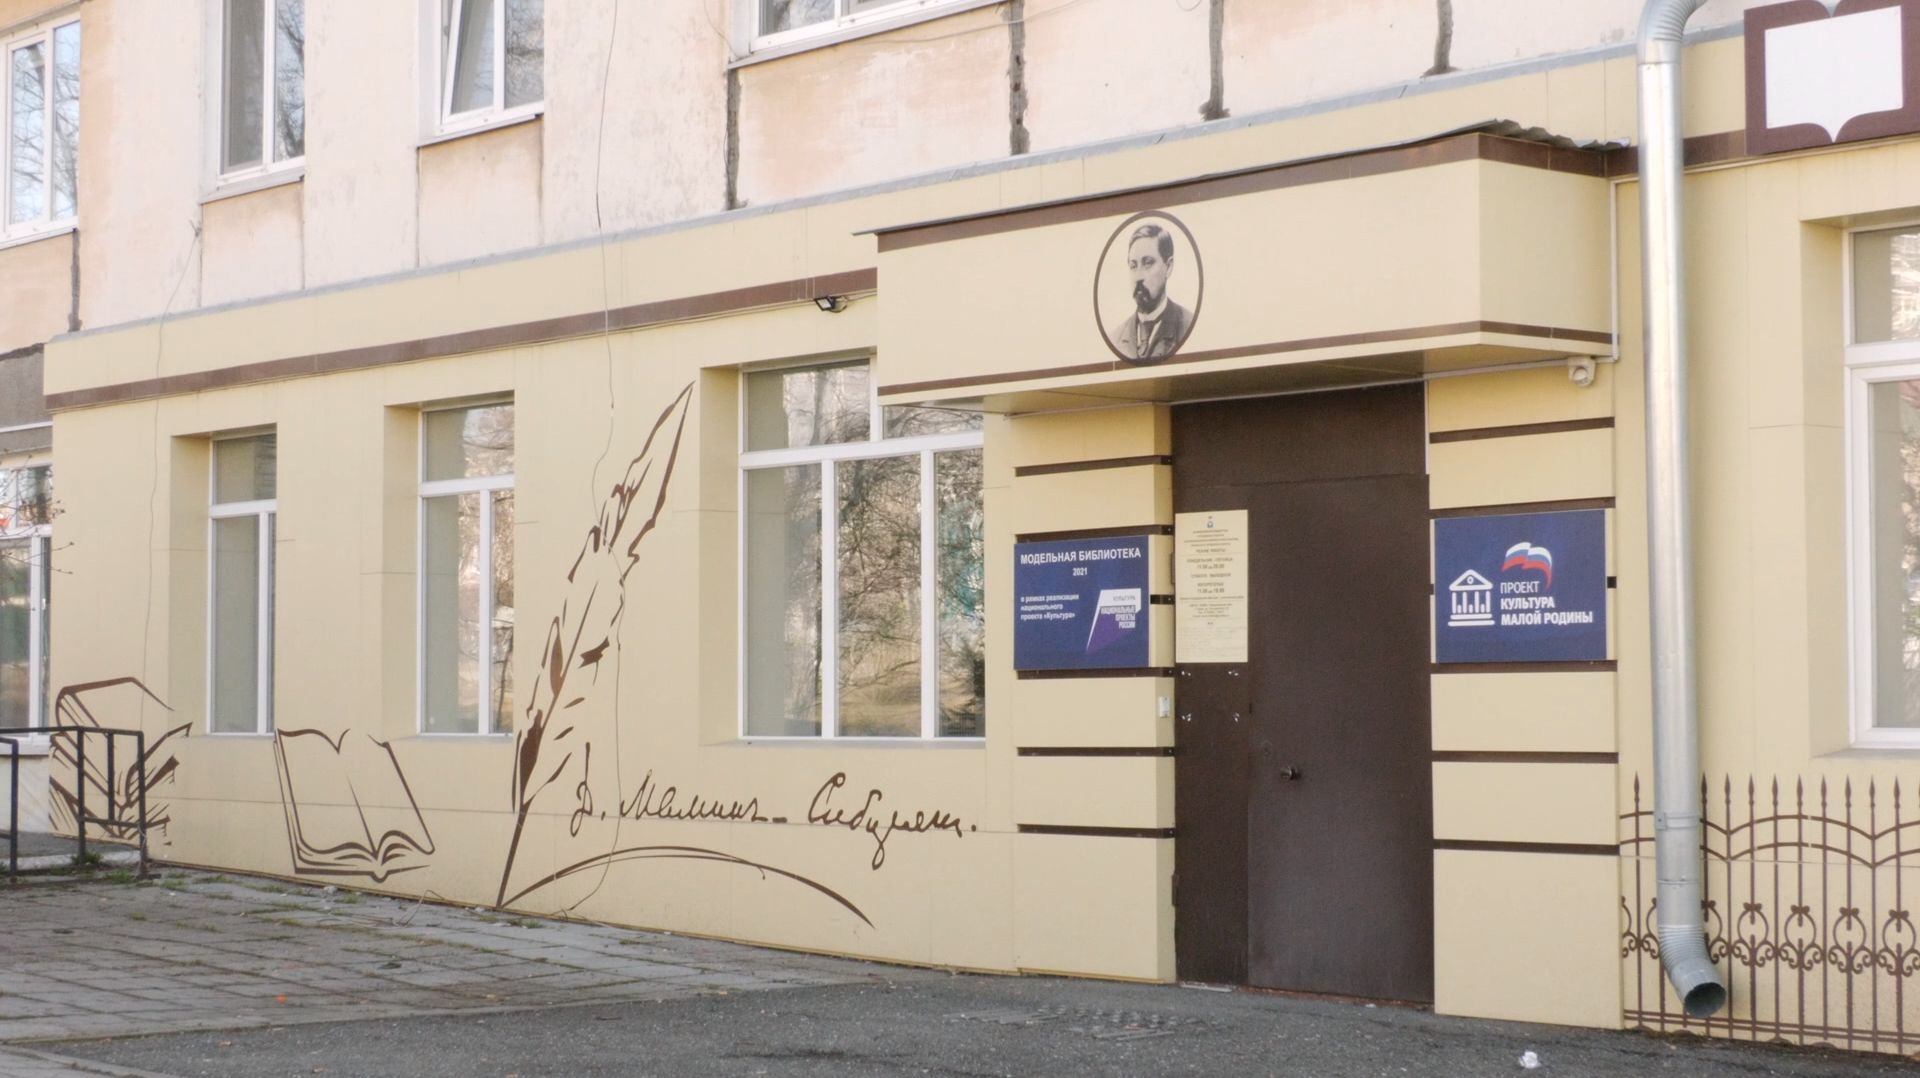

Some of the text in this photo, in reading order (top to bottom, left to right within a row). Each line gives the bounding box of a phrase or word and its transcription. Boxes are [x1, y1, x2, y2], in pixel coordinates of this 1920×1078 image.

[1020, 547, 1141, 565] МОДЕЛЬНАЯ БИБЛИОТЕКА
[1072, 568, 1088, 576] 2021
[1500, 581, 1540, 594] ПРОЕКТ
[1500, 596, 1555, 610] КУЛЬТУРА
[1501, 610, 1593, 626] МАЛОЙ РОДИНЫ
